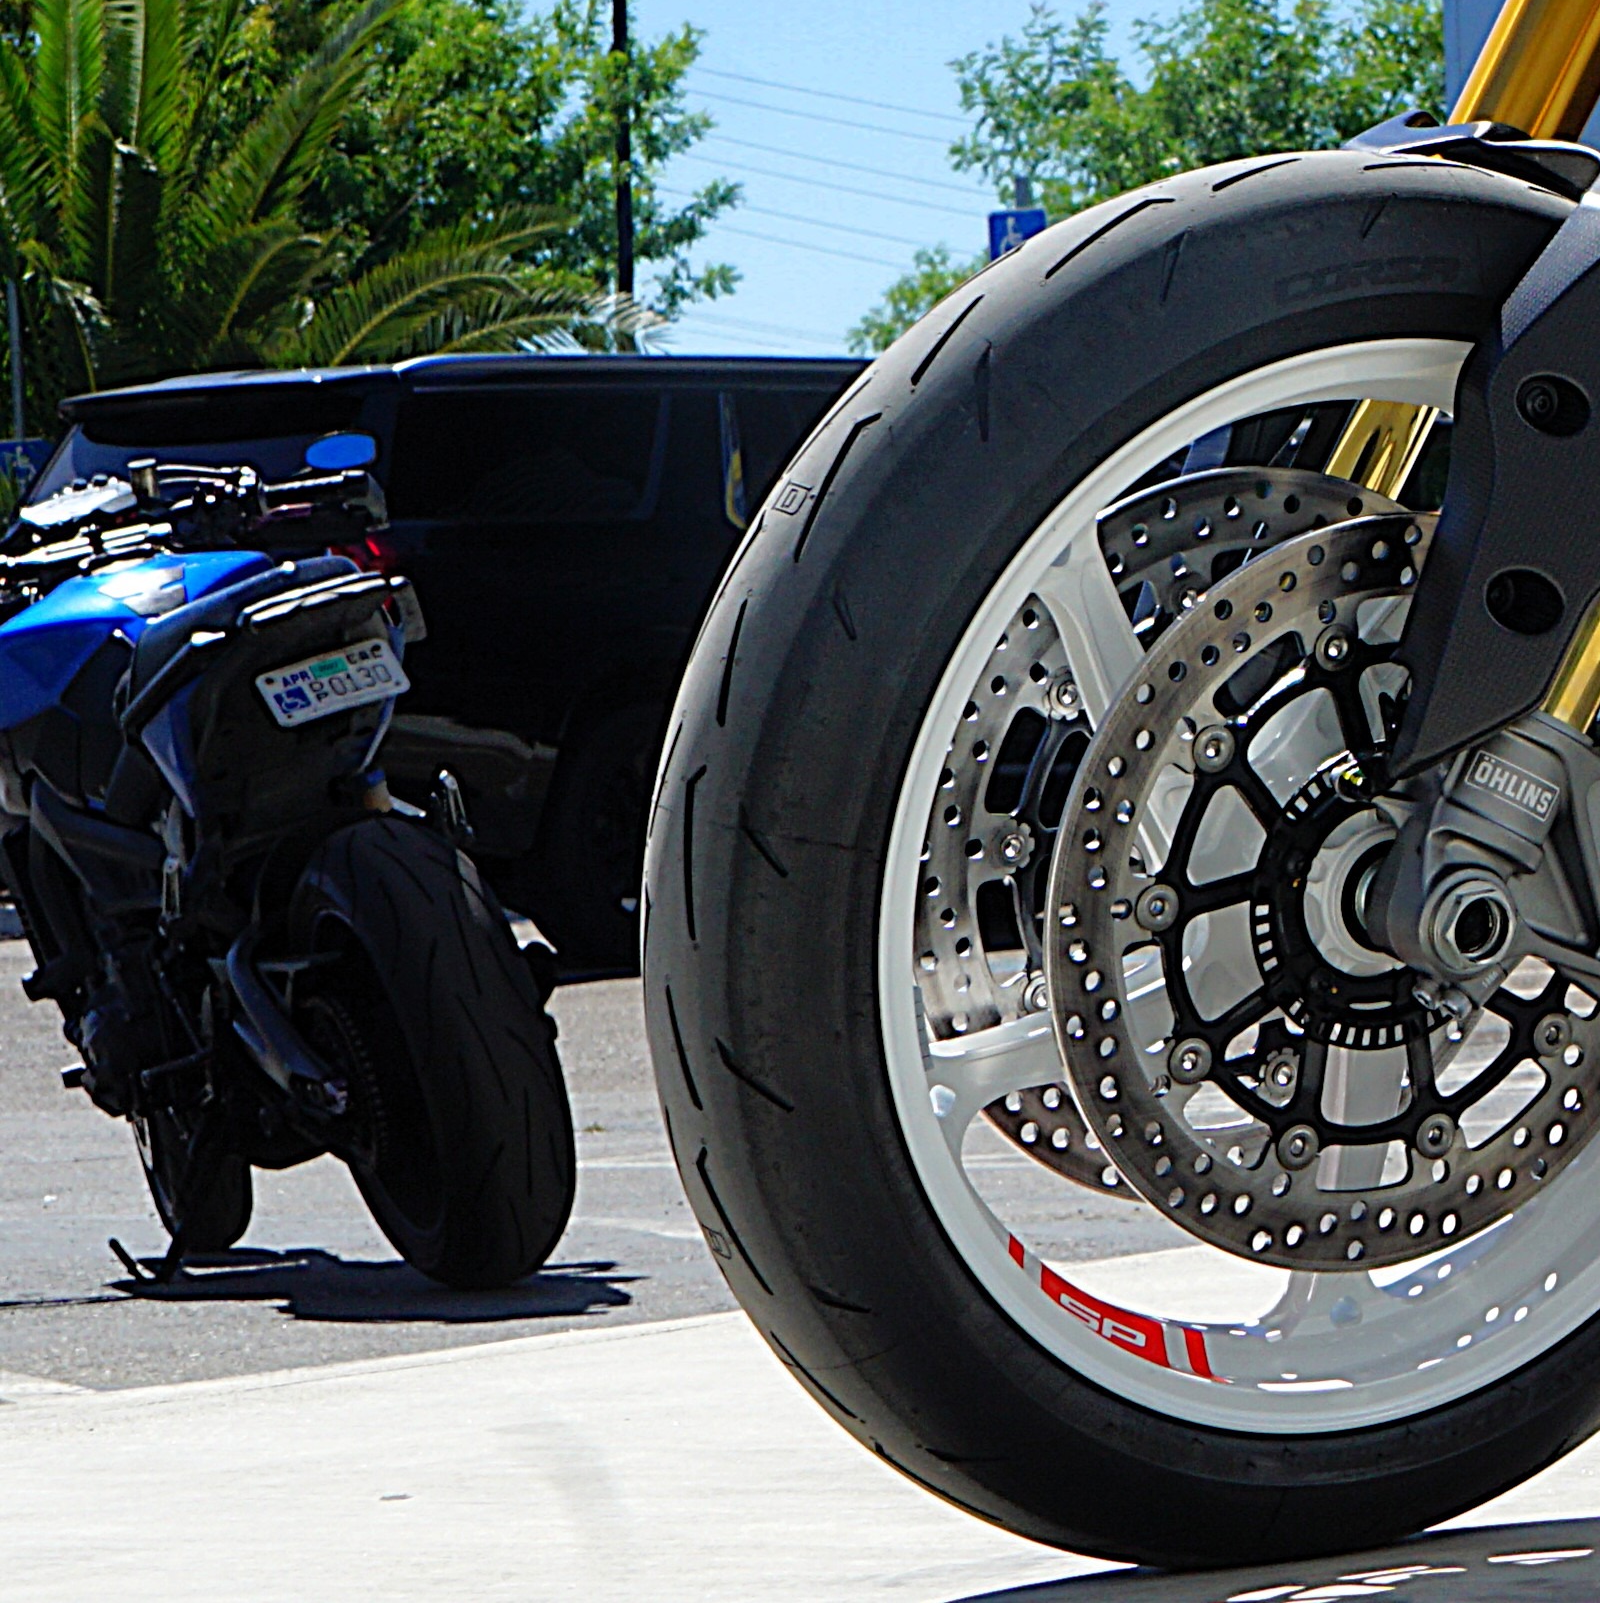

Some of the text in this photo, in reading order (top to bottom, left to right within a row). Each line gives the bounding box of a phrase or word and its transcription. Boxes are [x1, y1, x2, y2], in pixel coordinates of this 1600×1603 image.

[281, 670, 312, 688] APR
[1474, 756, 1552, 814] ÖHLINS
[1060, 1293, 1146, 1347] SP
